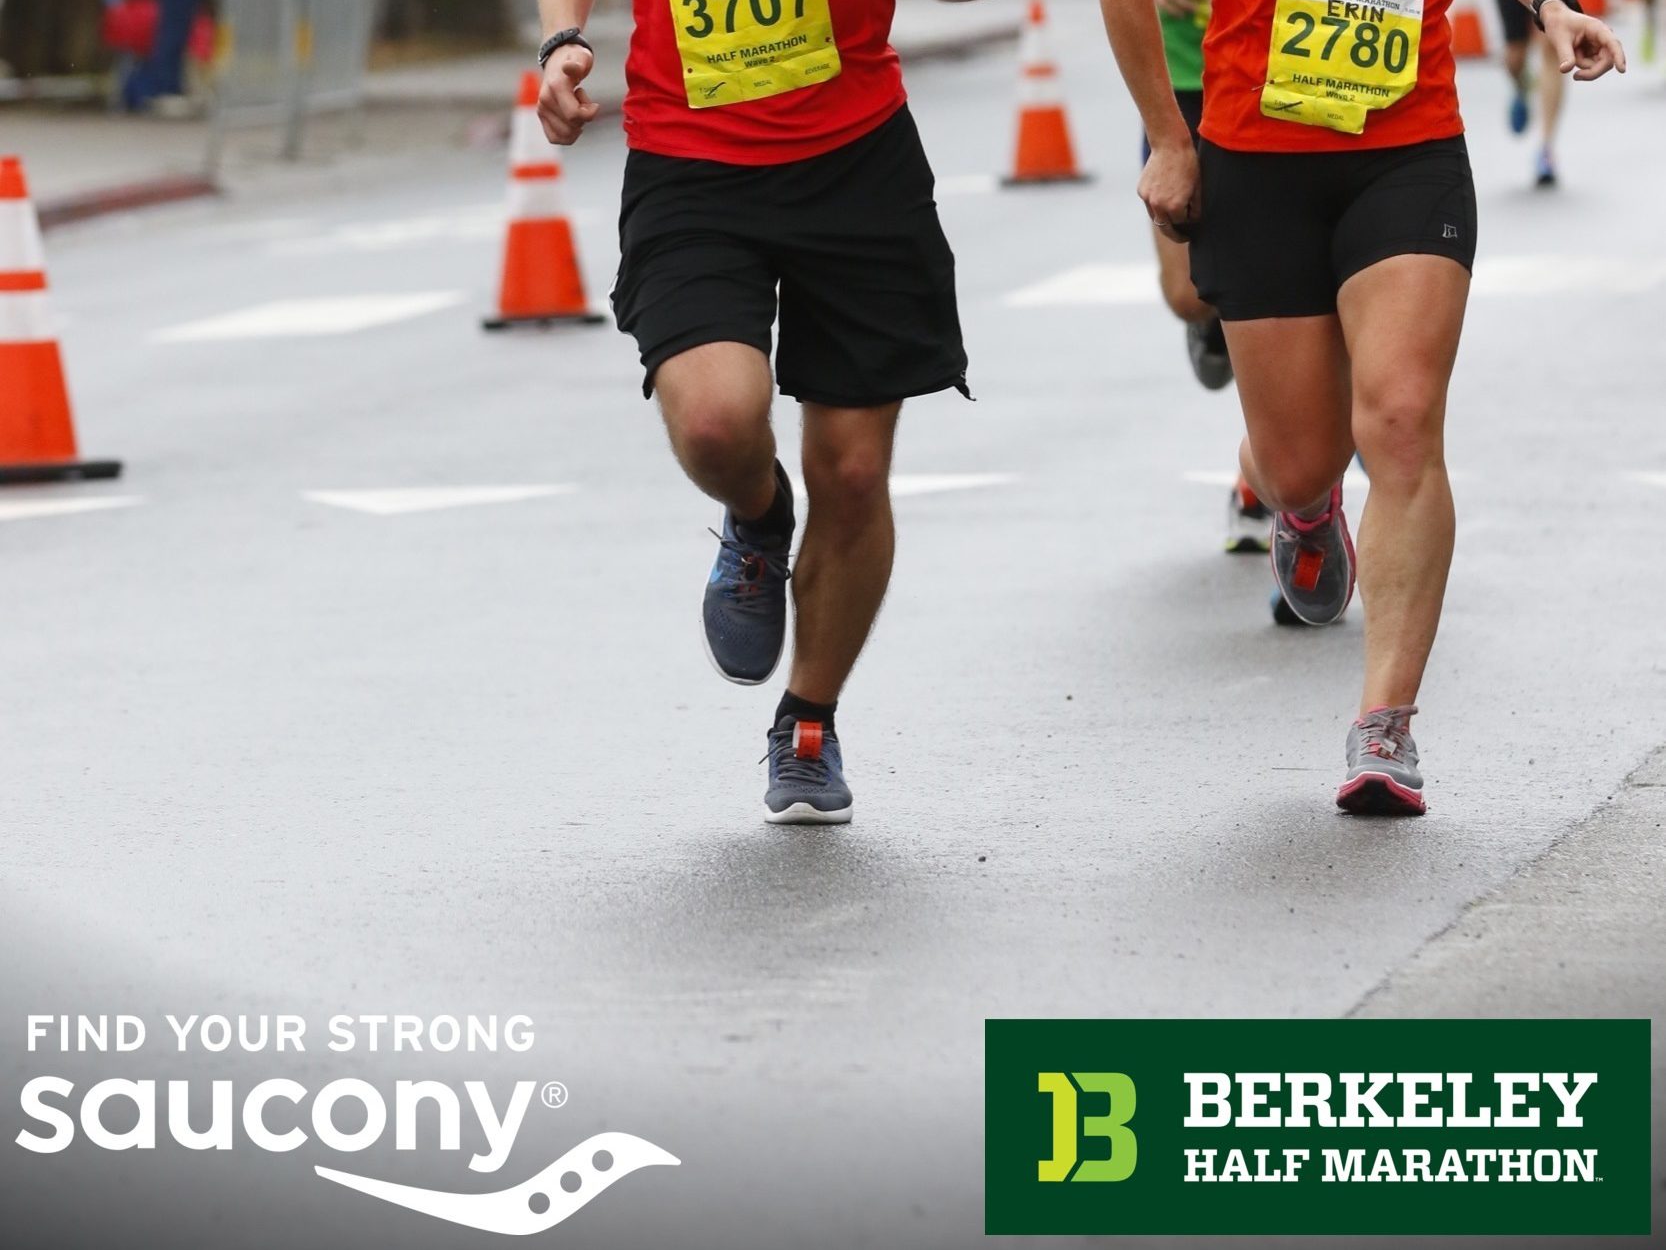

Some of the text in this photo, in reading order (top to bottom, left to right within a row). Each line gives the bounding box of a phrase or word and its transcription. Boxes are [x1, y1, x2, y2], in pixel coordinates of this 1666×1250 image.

[1327, 0, 1385, 23] ERIN
[707, 34, 807, 64] HALF MARATHON
[1281, 11, 1410, 74] 2780
[744, 57, 769, 68] Wave
[1292, 73, 1390, 98] HALF MARATHON
